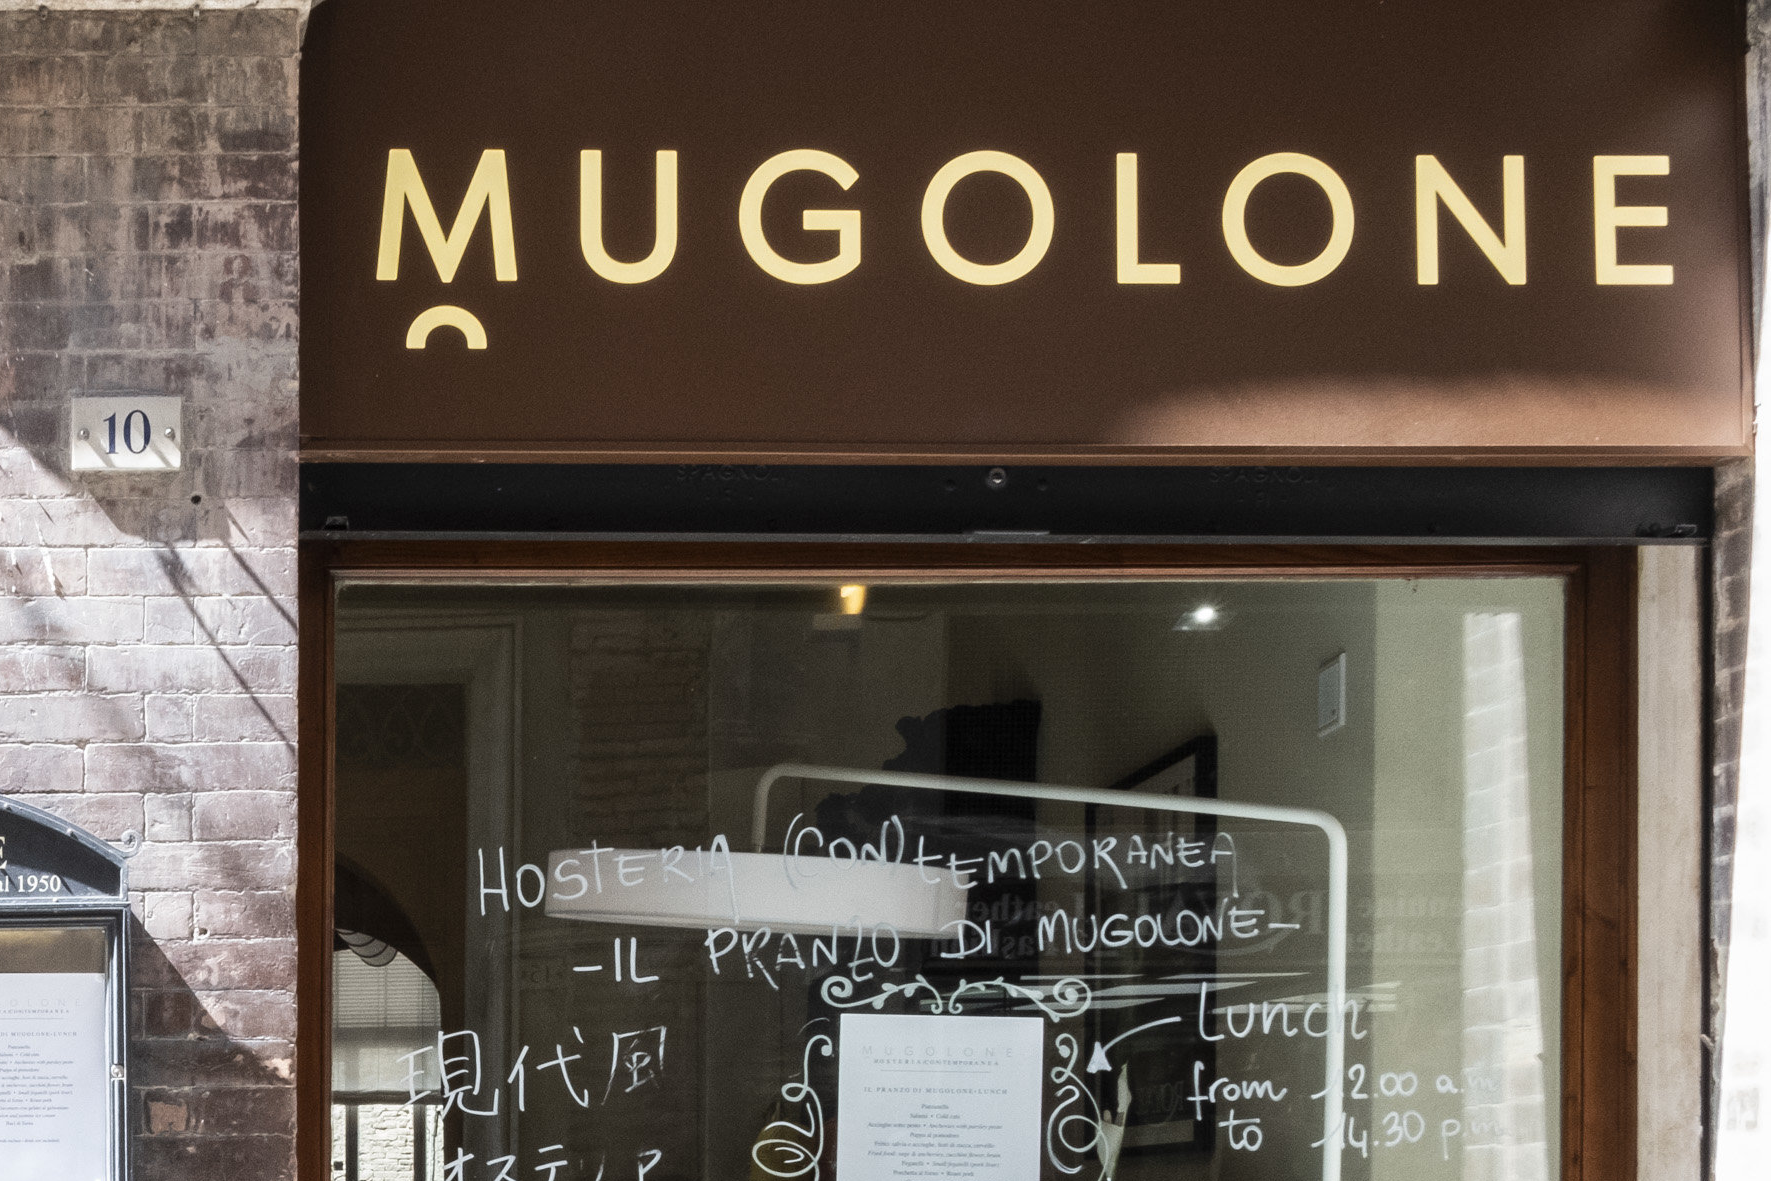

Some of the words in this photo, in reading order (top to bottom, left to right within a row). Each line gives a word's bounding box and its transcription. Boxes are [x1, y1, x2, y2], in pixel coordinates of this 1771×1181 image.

[375, 147, 1675, 288] MUGOLONE
[102, 409, 152, 455] 10
[17, 875, 62, 893] 1950
[478, 833, 739, 925] HOSTERIA
[704, 916, 900, 990] PRANZO
[940, 919, 992, 958] DI
[1198, 981, 1368, 1042] Lunch
[396, 1025, 667, 1121] 現代風
[1186, 1061, 1288, 1121] from
[1218, 1108, 1263, 1151] to
[1311, 1110, 1426, 1158] 14.30
